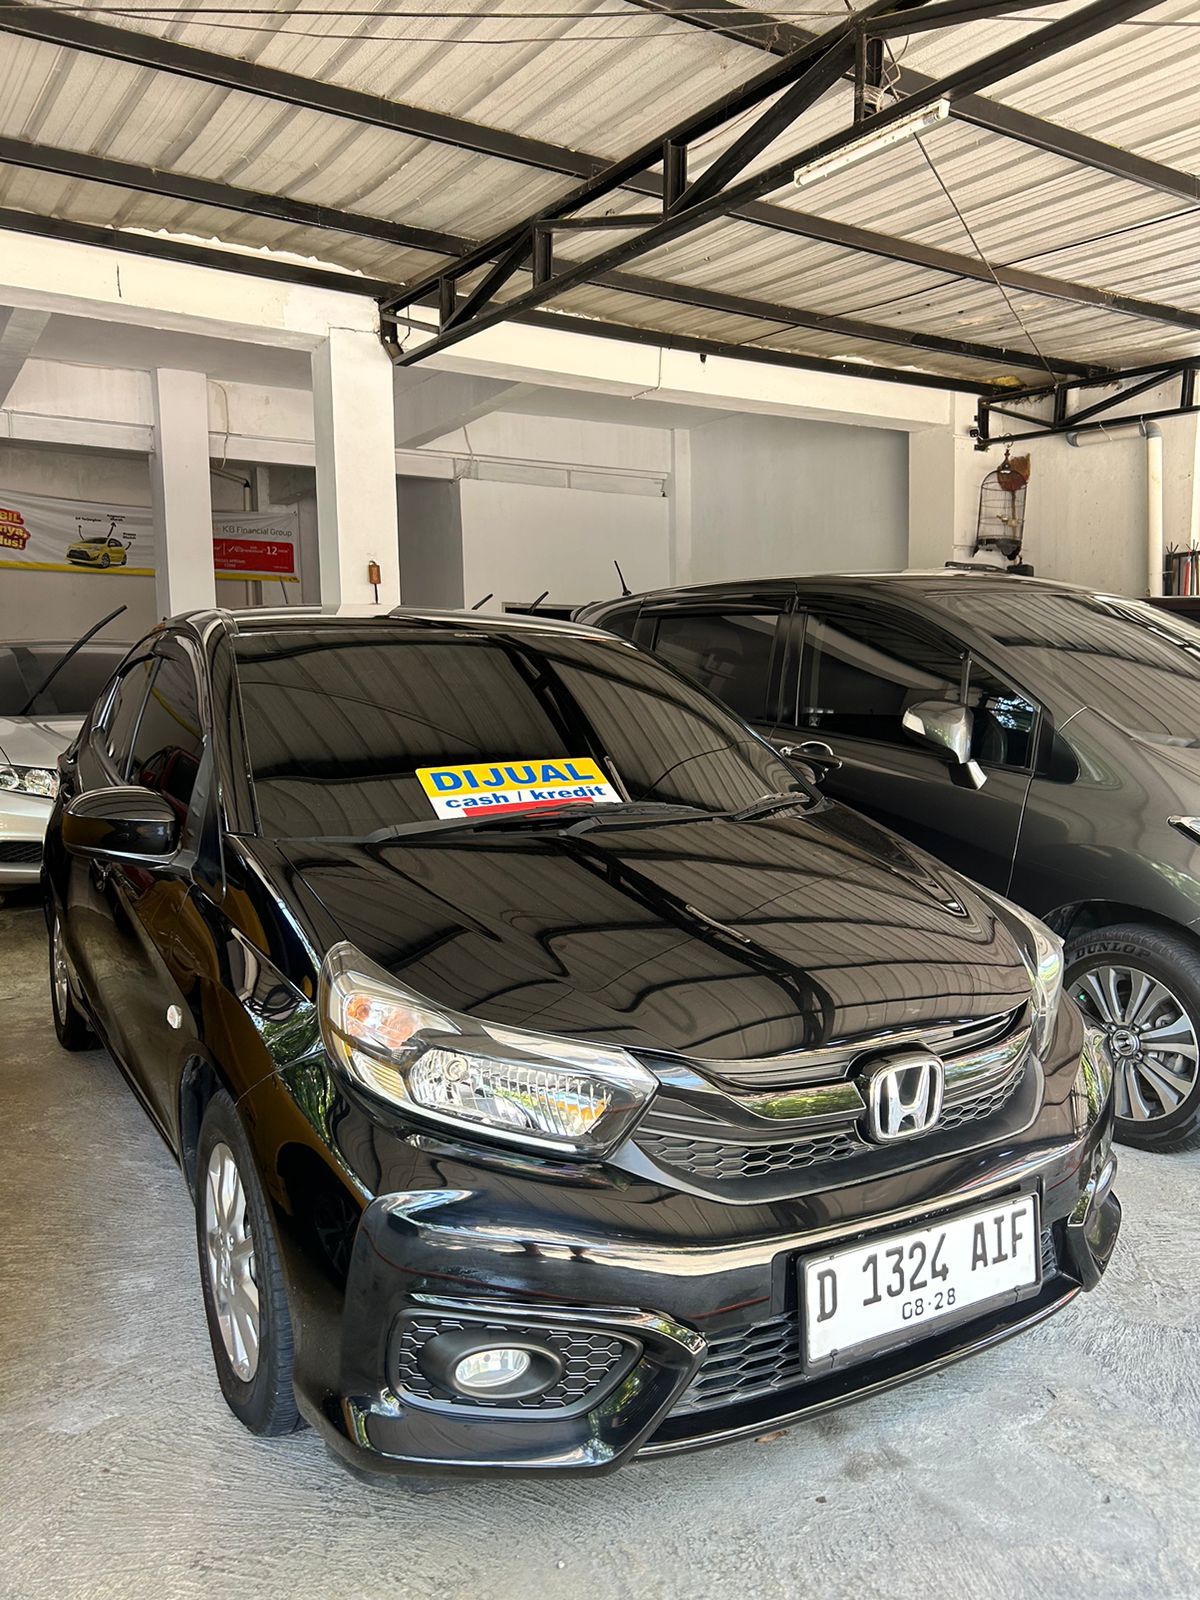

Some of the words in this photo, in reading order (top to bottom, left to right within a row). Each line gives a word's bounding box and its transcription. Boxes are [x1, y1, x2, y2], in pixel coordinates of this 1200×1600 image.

[236, 526, 269, 535] Financial
[269, 528, 293, 537] Group
[266, 545, 278, 556] 12
[429, 762, 595, 792] DIJUAL
[445, 792, 510, 809] cash
[529, 785, 607, 801] kredit
[1075, 942, 1152, 961] DUNLOP
[816, 1268, 838, 1323] D
[862, 1232, 950, 1307] 1324
[971, 1208, 1028, 1272] AIF
